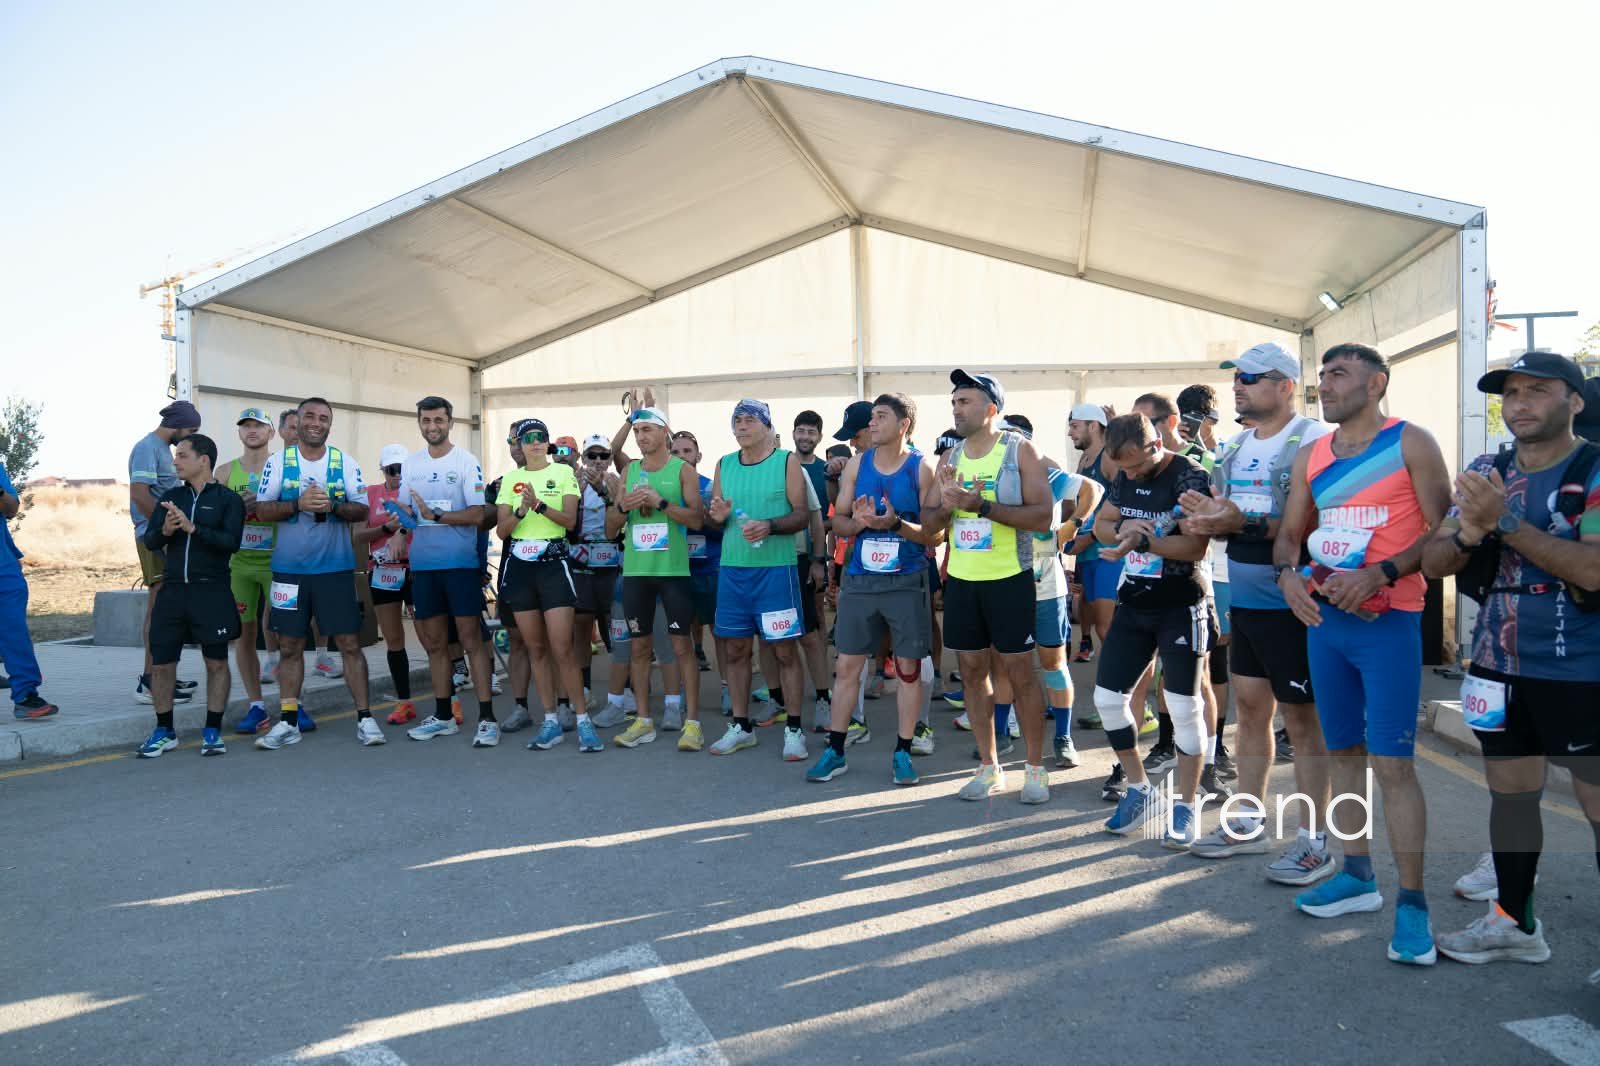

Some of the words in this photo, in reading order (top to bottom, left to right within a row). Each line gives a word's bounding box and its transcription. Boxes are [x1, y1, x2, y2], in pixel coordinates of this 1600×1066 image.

[641, 533, 658, 543] 097
[960, 530, 980, 541] 063
[522, 545, 539, 554] 065
[1322, 540, 1350, 557] 087
[871, 551, 890, 563] 027
[273, 591, 288, 602] 090
[772, 619, 791, 631] 068
[1465, 693, 1488, 715] 080
